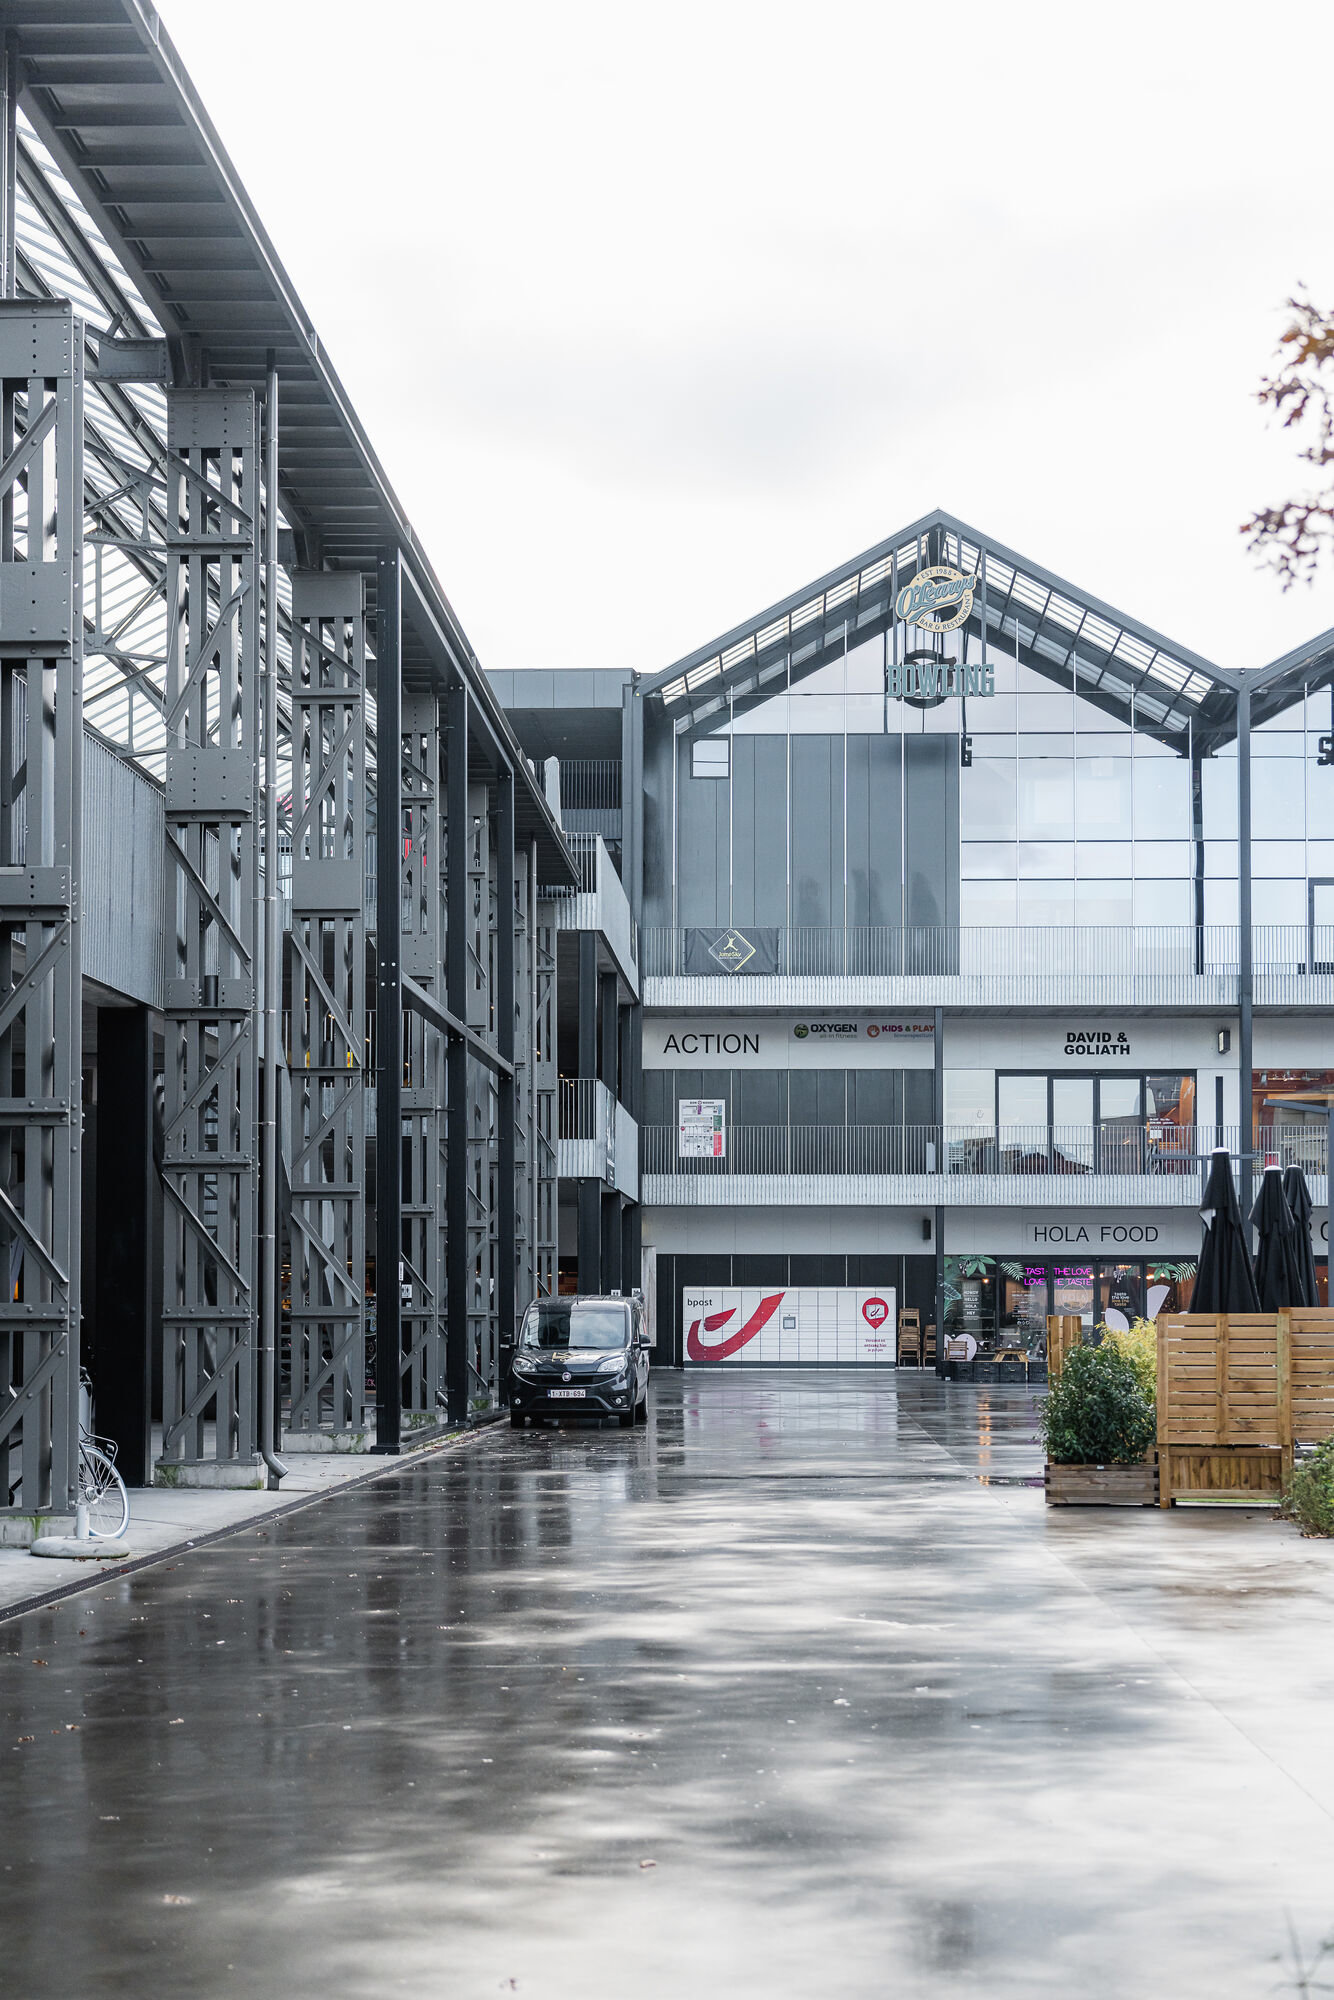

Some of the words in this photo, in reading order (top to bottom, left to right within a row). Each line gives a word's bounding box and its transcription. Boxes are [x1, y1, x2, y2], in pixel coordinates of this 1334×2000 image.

[921, 569, 933, 579] EST
[936, 568, 952, 576] 1988
[897, 575, 976, 620] O'Learys
[920, 618, 933, 630] BAR
[942, 594, 971, 630] RESTAURANT
[886, 663, 995, 698] BOWLING
[810, 1024, 858, 1032] OXYGEN
[1066, 1032, 1112, 1042] DAVID
[1117, 1032, 1128, 1042] &
[664, 1034, 759, 1054] ACTION
[1064, 1044, 1130, 1056] GOLIATH
[1034, 1226, 1089, 1242] HOLA
[1100, 1226, 1158, 1242] FOOD
[1054, 1267, 1070, 1276] THE
[1072, 1268, 1092, 1276] LOVE
[688, 1298, 712, 1308] bpost
